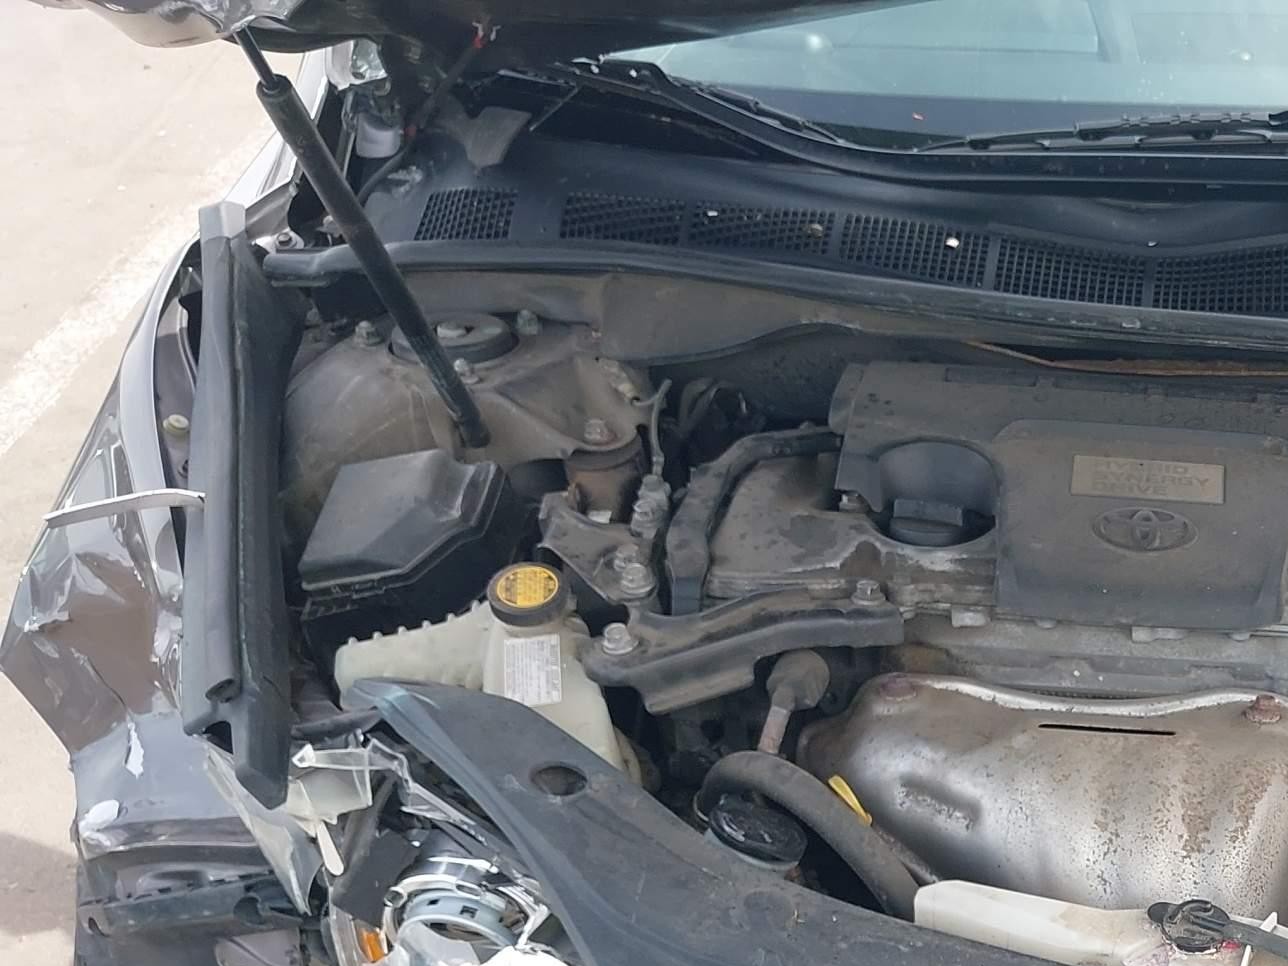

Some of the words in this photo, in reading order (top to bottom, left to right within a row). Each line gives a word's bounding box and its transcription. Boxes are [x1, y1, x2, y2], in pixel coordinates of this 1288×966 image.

[1094, 459, 1189, 475] HYBRID
[1094, 471, 1209, 488] SYNERGY
[1092, 481, 1169, 496] DRIVE
